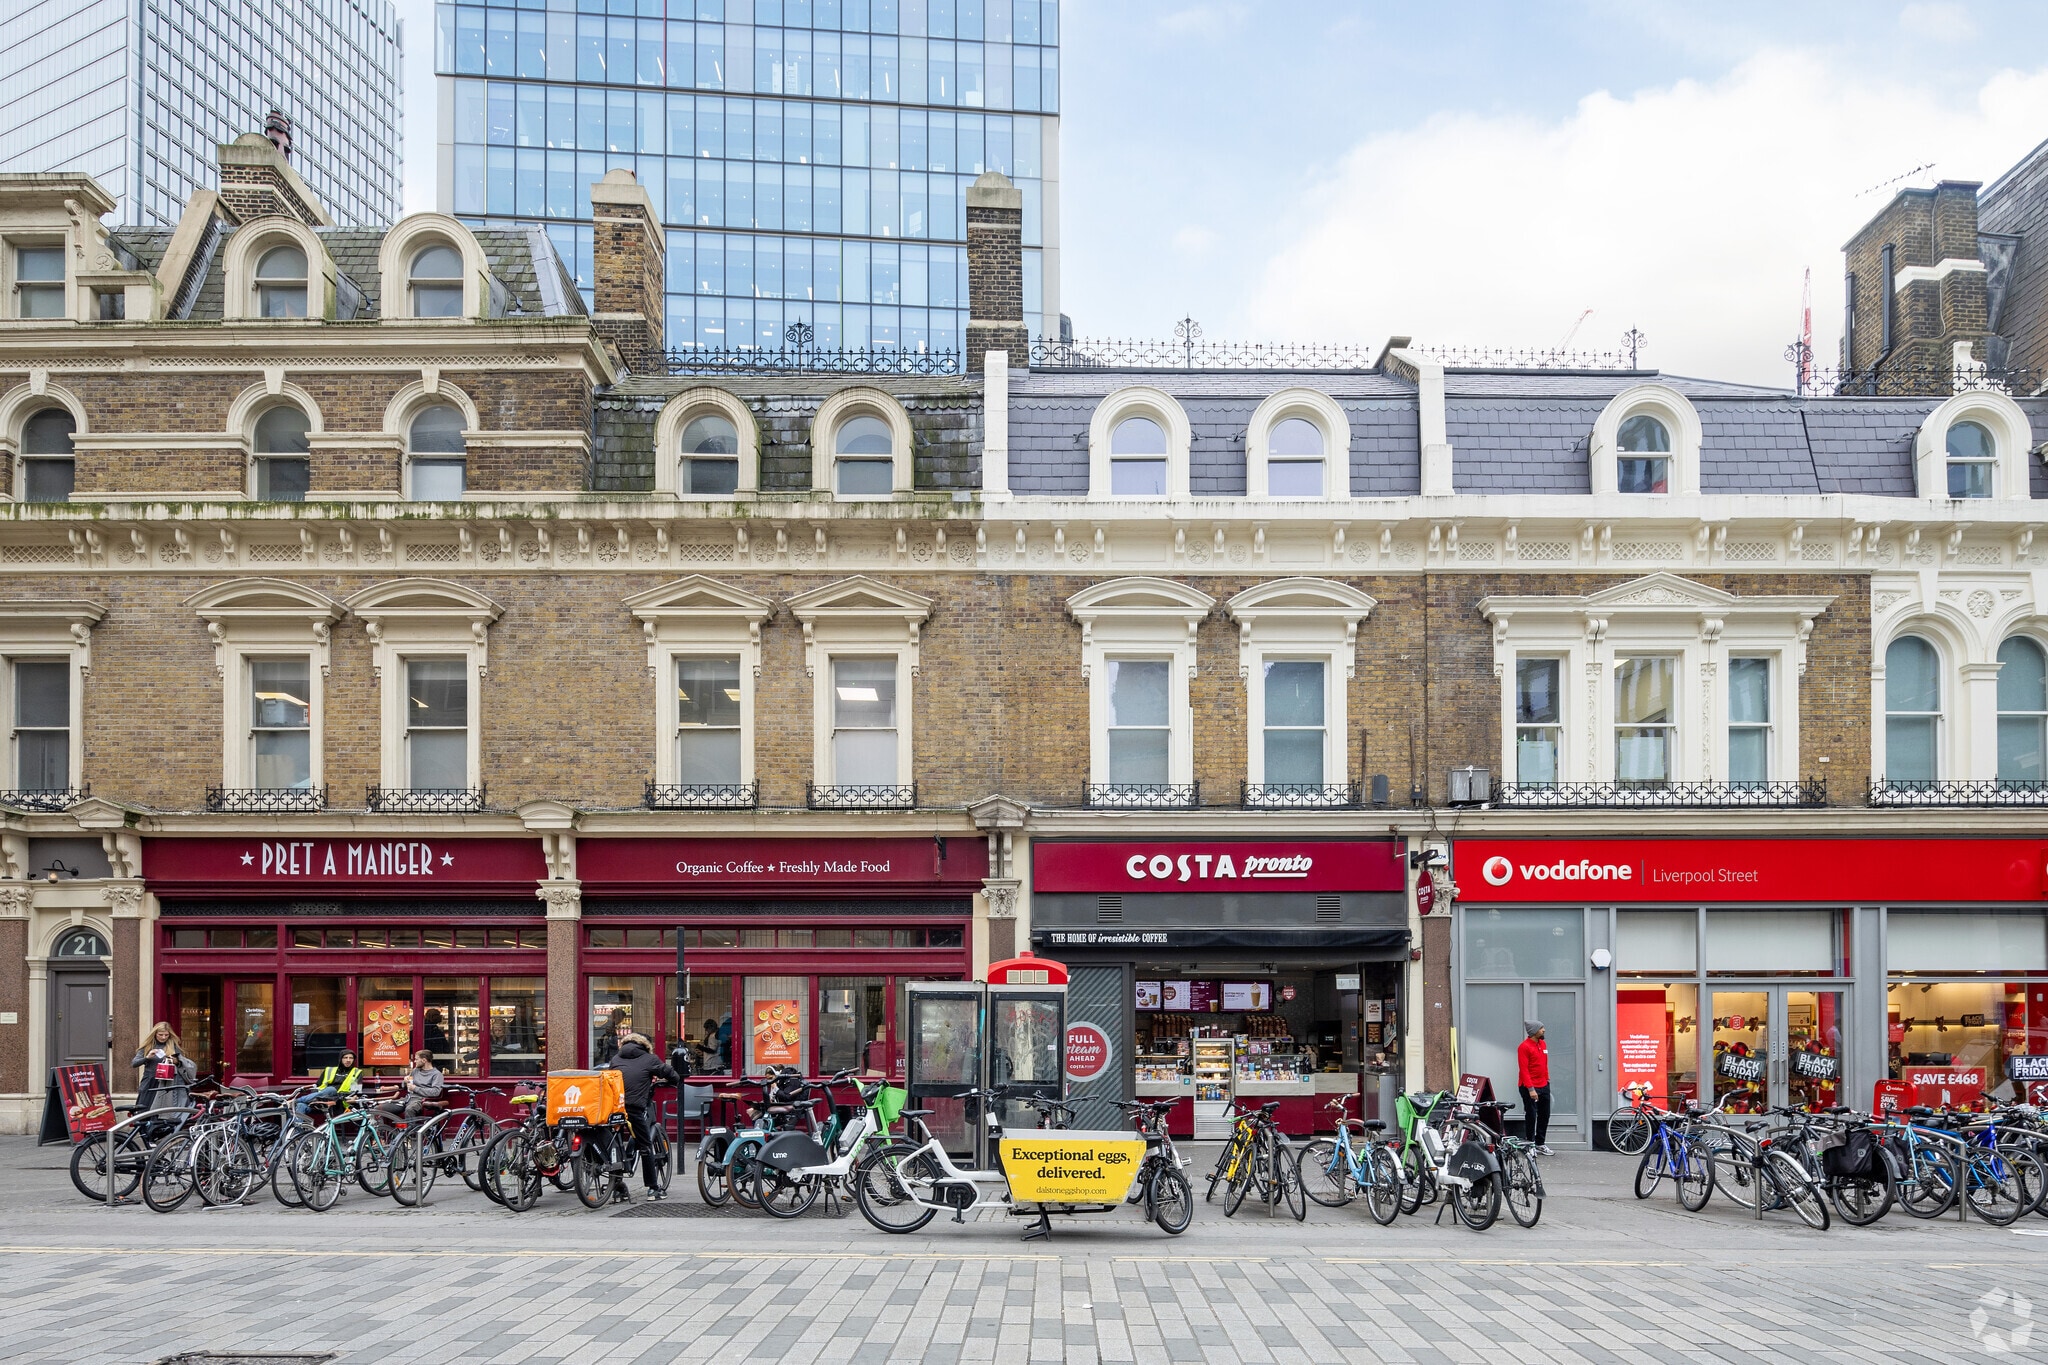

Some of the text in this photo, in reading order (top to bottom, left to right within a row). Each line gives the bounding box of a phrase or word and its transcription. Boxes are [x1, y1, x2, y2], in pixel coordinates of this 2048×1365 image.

[262, 842, 433, 875] PRET A MANGER
[676, 861, 890, 876] Organic Coffee Freshly Made Food
[1126, 854, 1312, 882] COSTA pronto
[1520, 859, 1758, 884] vodafone Liverpool Street
[1418, 885, 1430, 896] COSTA
[1051, 933, 1167, 943] THE HOME OF irresistible COFFEE
[74, 936, 96, 955] 21
[376, 1041, 395, 1050] Love,
[767, 1041, 786, 1050] Love,
[1069, 1035, 1095, 1043] FULL
[1067, 1044, 1101, 1054] steam
[1725, 1056, 1760, 1070] BLACK
[1800, 1054, 1835, 1069] BLACK
[2015, 1058, 2048, 1067] BLAC
[1724, 1064, 1758, 1078] FRIDAY
[1798, 1062, 1833, 1076] FRIDAY
[2015, 1068, 2048, 1076] FRIDA
[1913, 1073, 1978, 1085] SAVE £468
[1012, 1148, 1131, 1164] Exceptional eggs,
[1037, 1166, 1105, 1179] delivered.
[1036, 1186, 1107, 1196] dalstoneggshop.com
